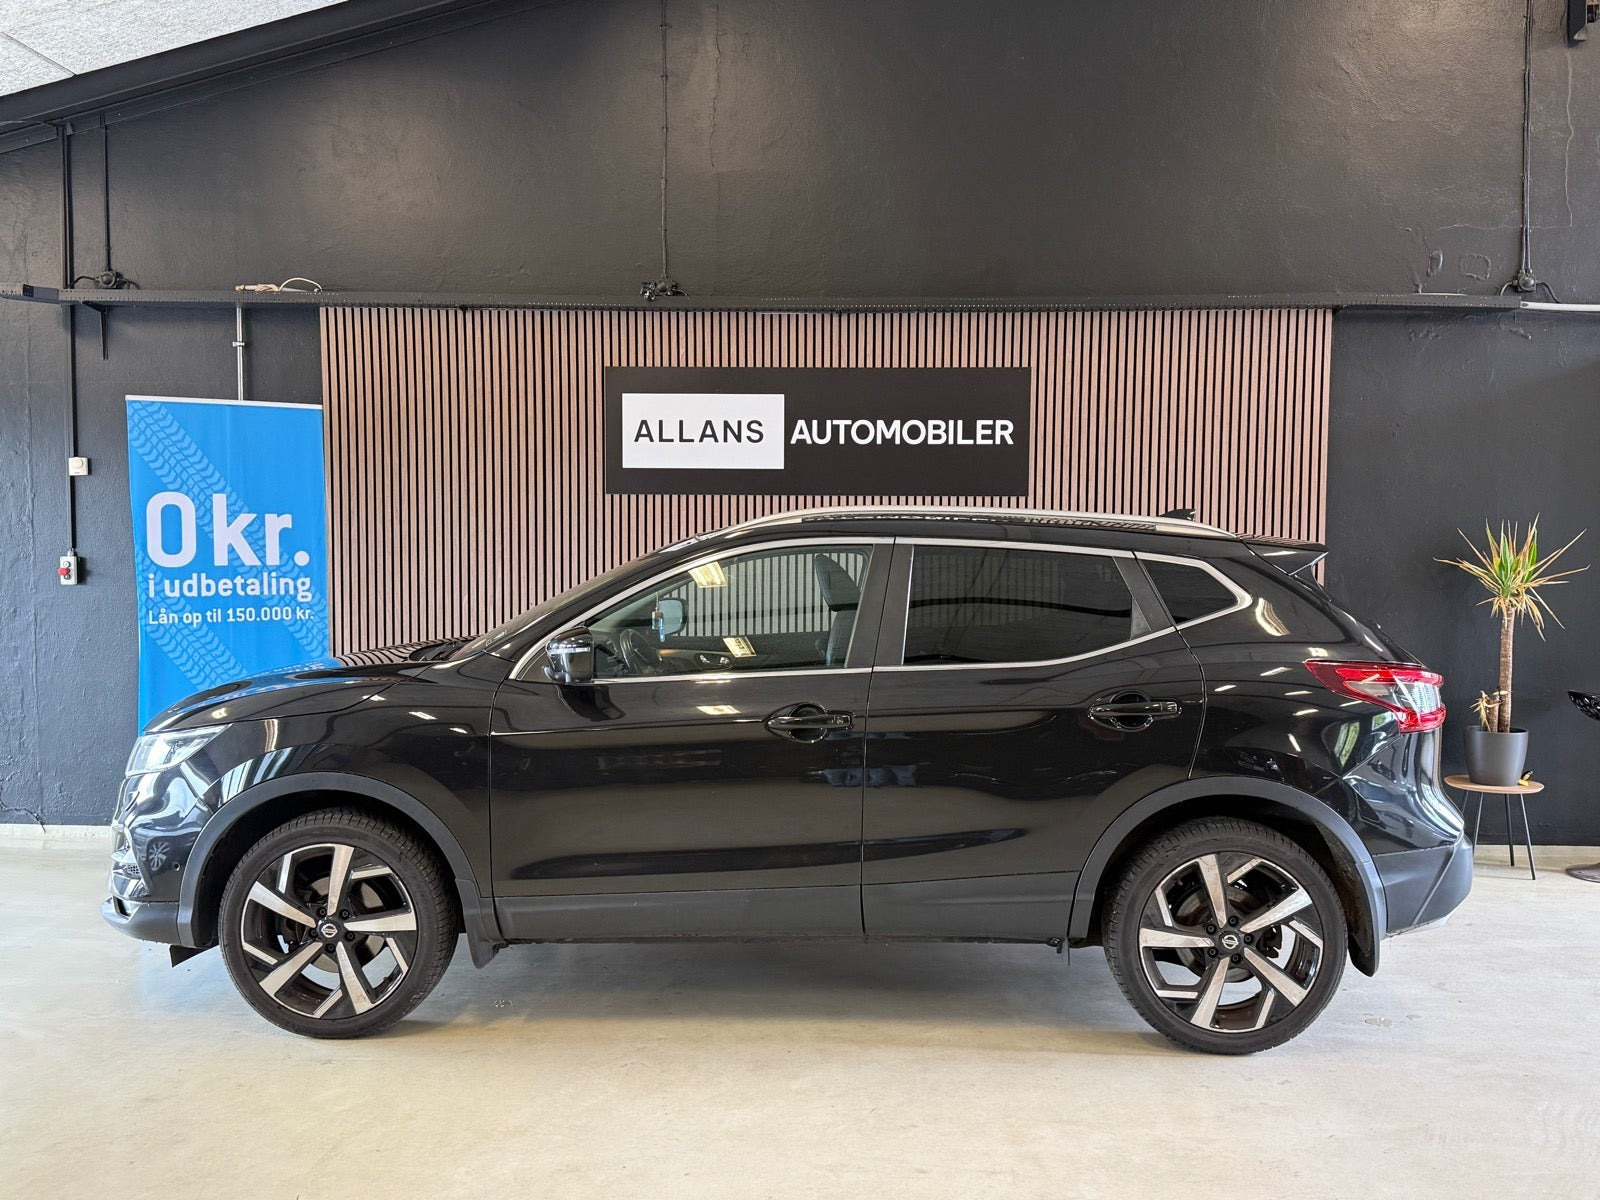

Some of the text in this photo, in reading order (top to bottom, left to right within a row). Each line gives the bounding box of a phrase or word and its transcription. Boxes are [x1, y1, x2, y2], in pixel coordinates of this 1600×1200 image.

[634, 419, 1014, 445] ALLANS AUTOMOBILER
[146, 491, 310, 568] 0 kr.
[148, 571, 313, 603] i udbetaling
[148, 606, 314, 628] Lån op til 150.000 kr.
